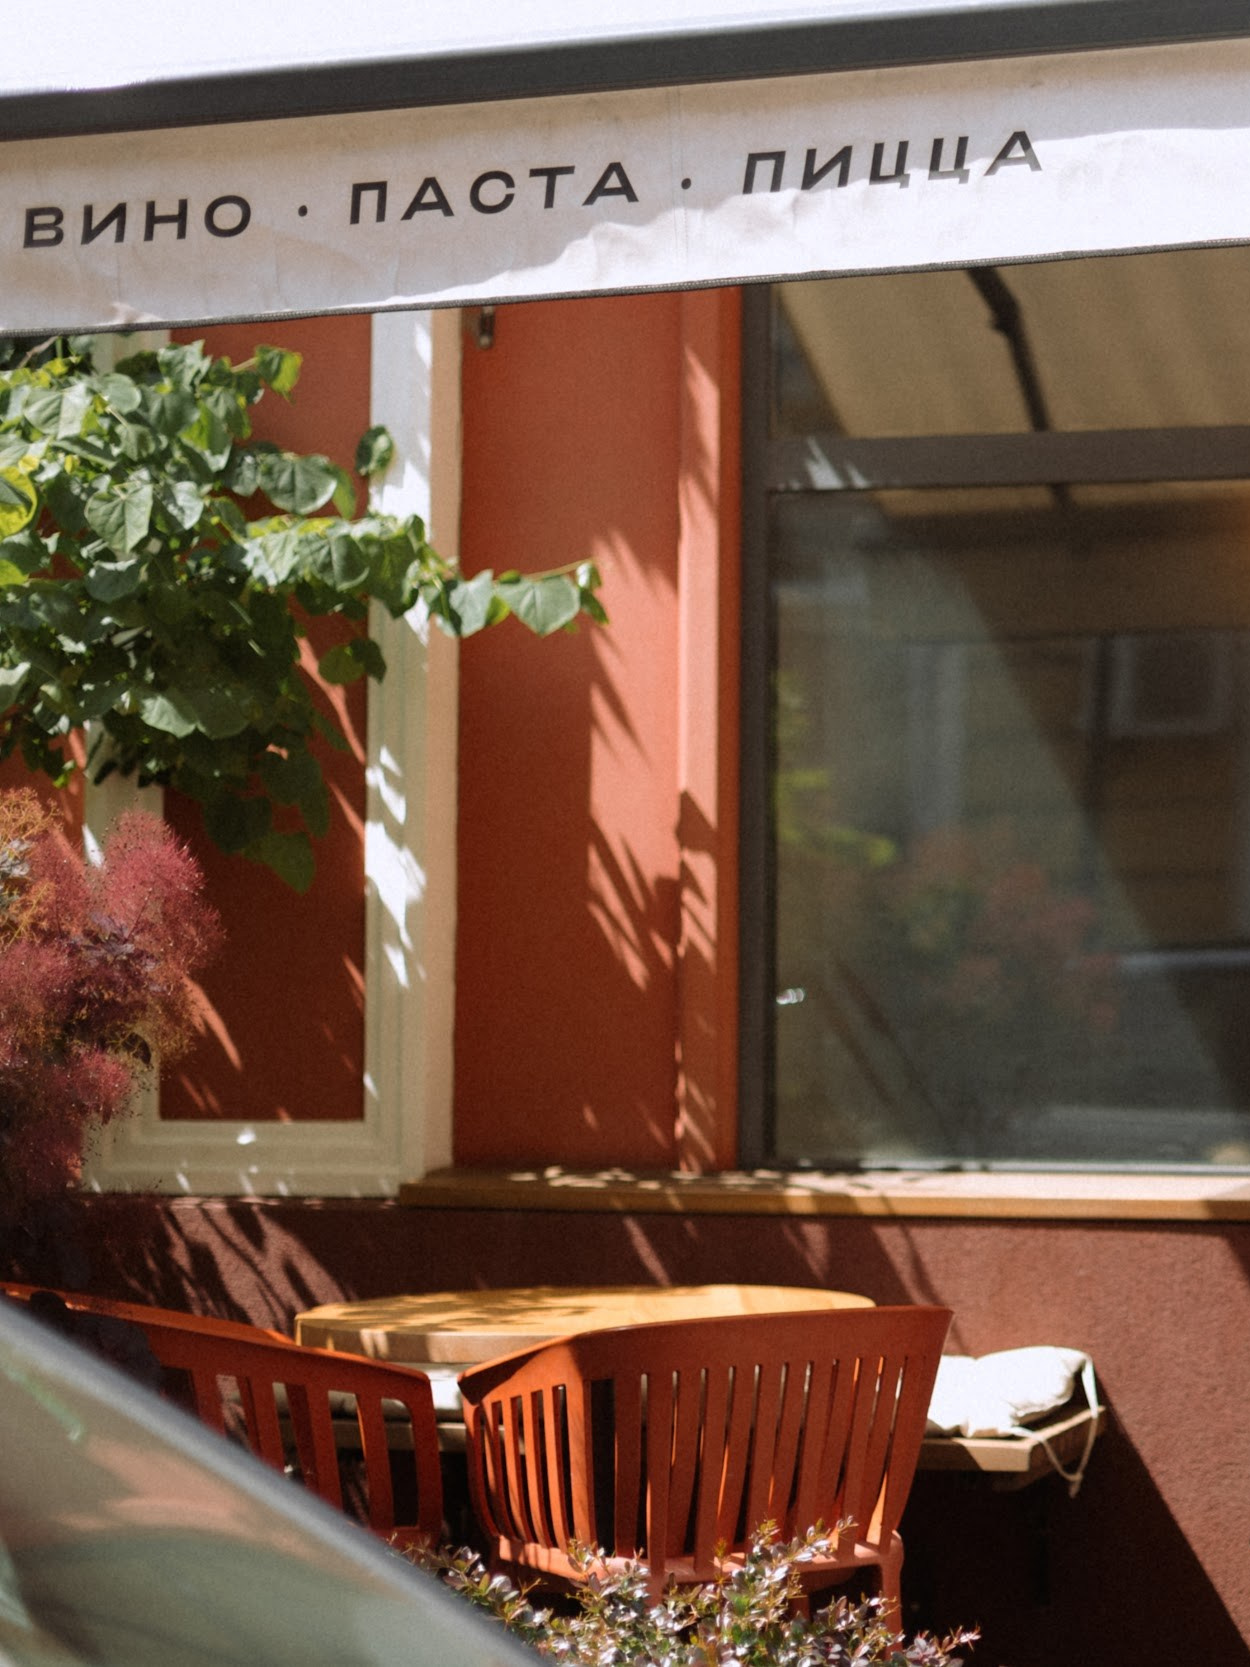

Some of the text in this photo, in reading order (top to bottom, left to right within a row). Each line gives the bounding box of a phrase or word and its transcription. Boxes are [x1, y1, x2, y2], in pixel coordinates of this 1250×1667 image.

[23, 195, 251, 249] ВИНО
[350, 161, 639, 225] ПАСТА
[742, 130, 1042, 195] ПИЦЦА
